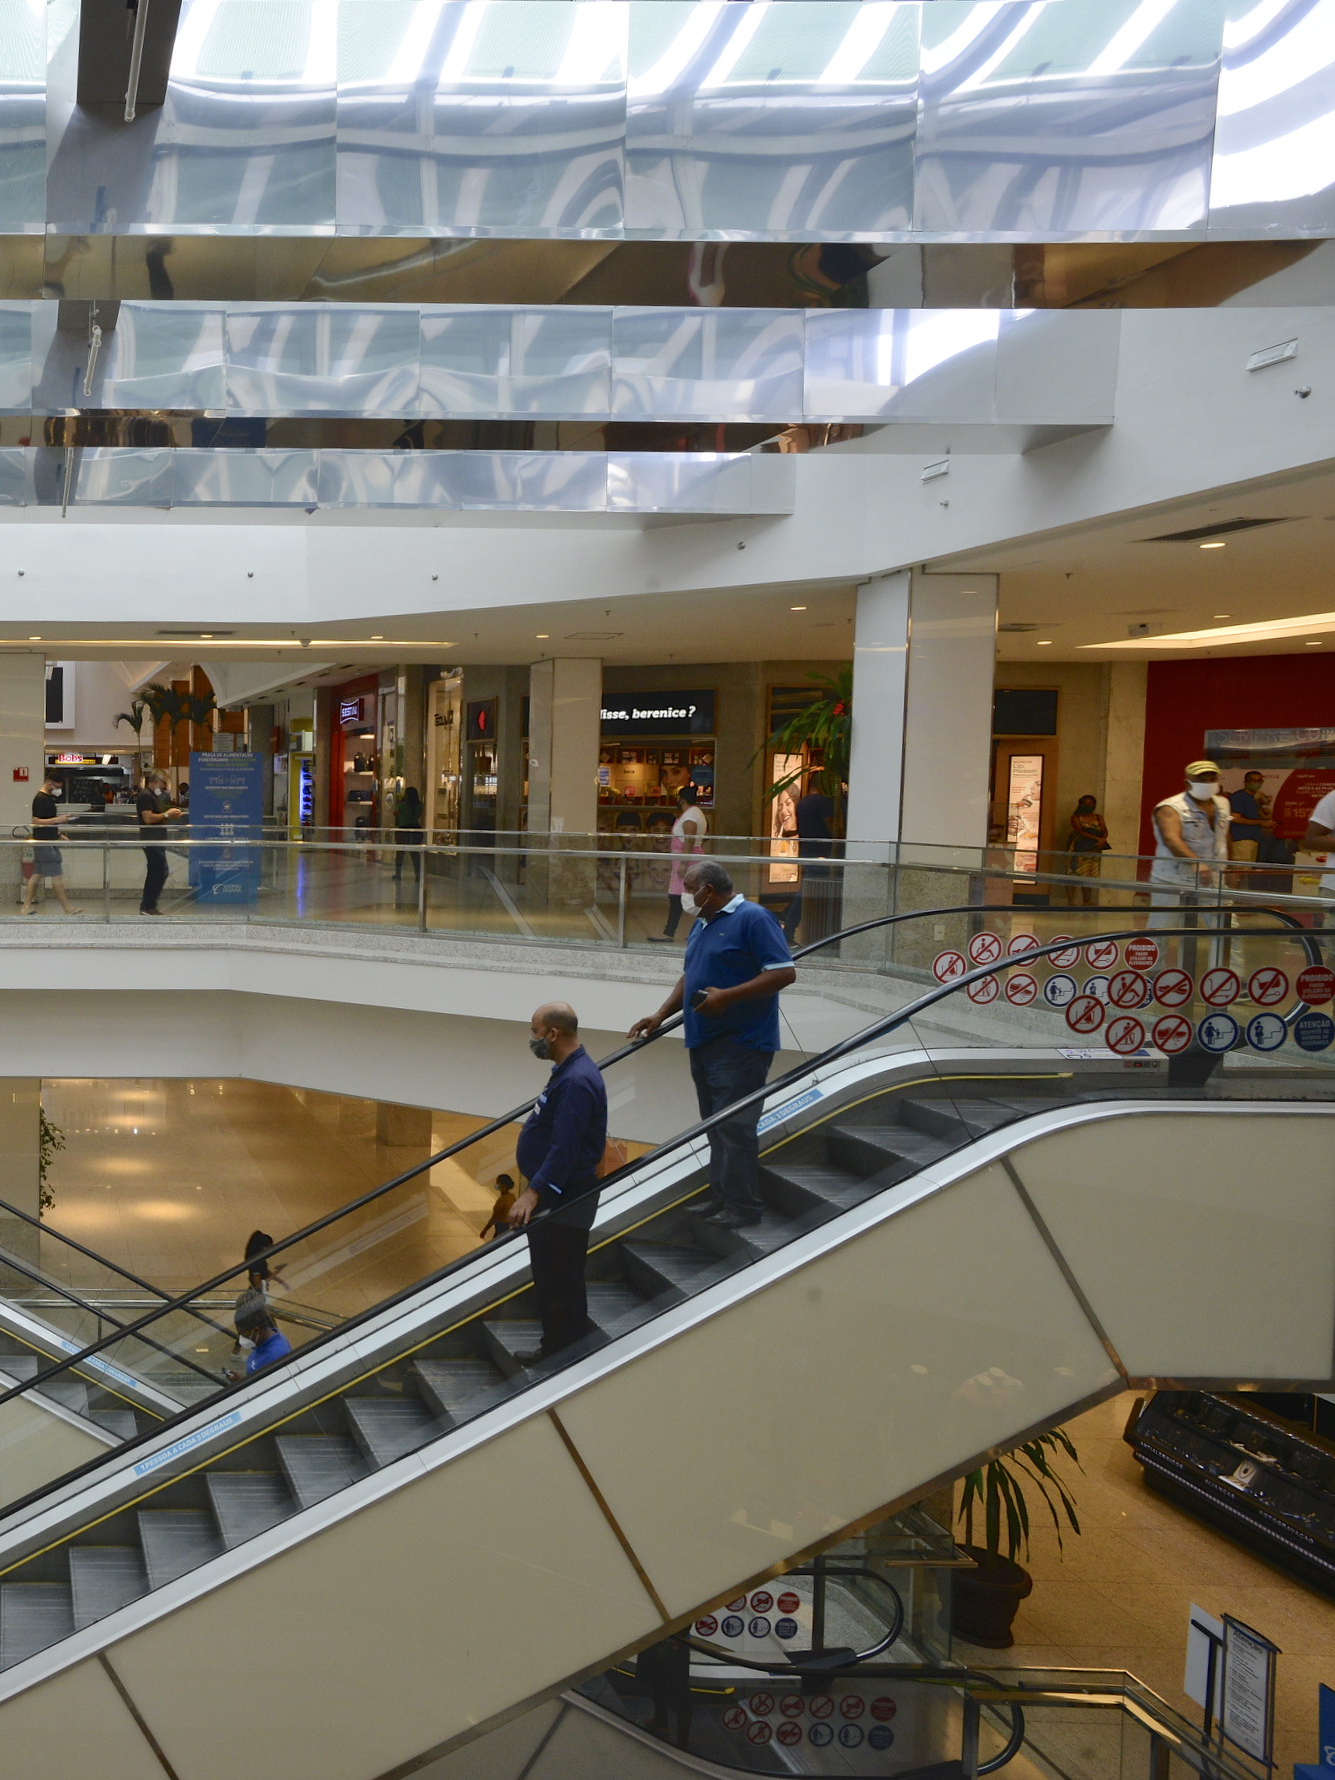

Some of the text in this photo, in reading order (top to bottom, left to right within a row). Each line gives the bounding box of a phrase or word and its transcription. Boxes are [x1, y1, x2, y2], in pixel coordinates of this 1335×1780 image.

[1300, 974, 1334, 982] PROIBIDO
[1299, 1018, 1331, 1029] ATENÇÃO
[780, 1095, 814, 1117] DEGRAUS
[145, 1450, 172, 1469] PESSOA
[178, 1437, 197, 1451] CADA
[201, 1417, 233, 1441] DEGRAUS
[1233, 1630, 1263, 1655] Atenção
